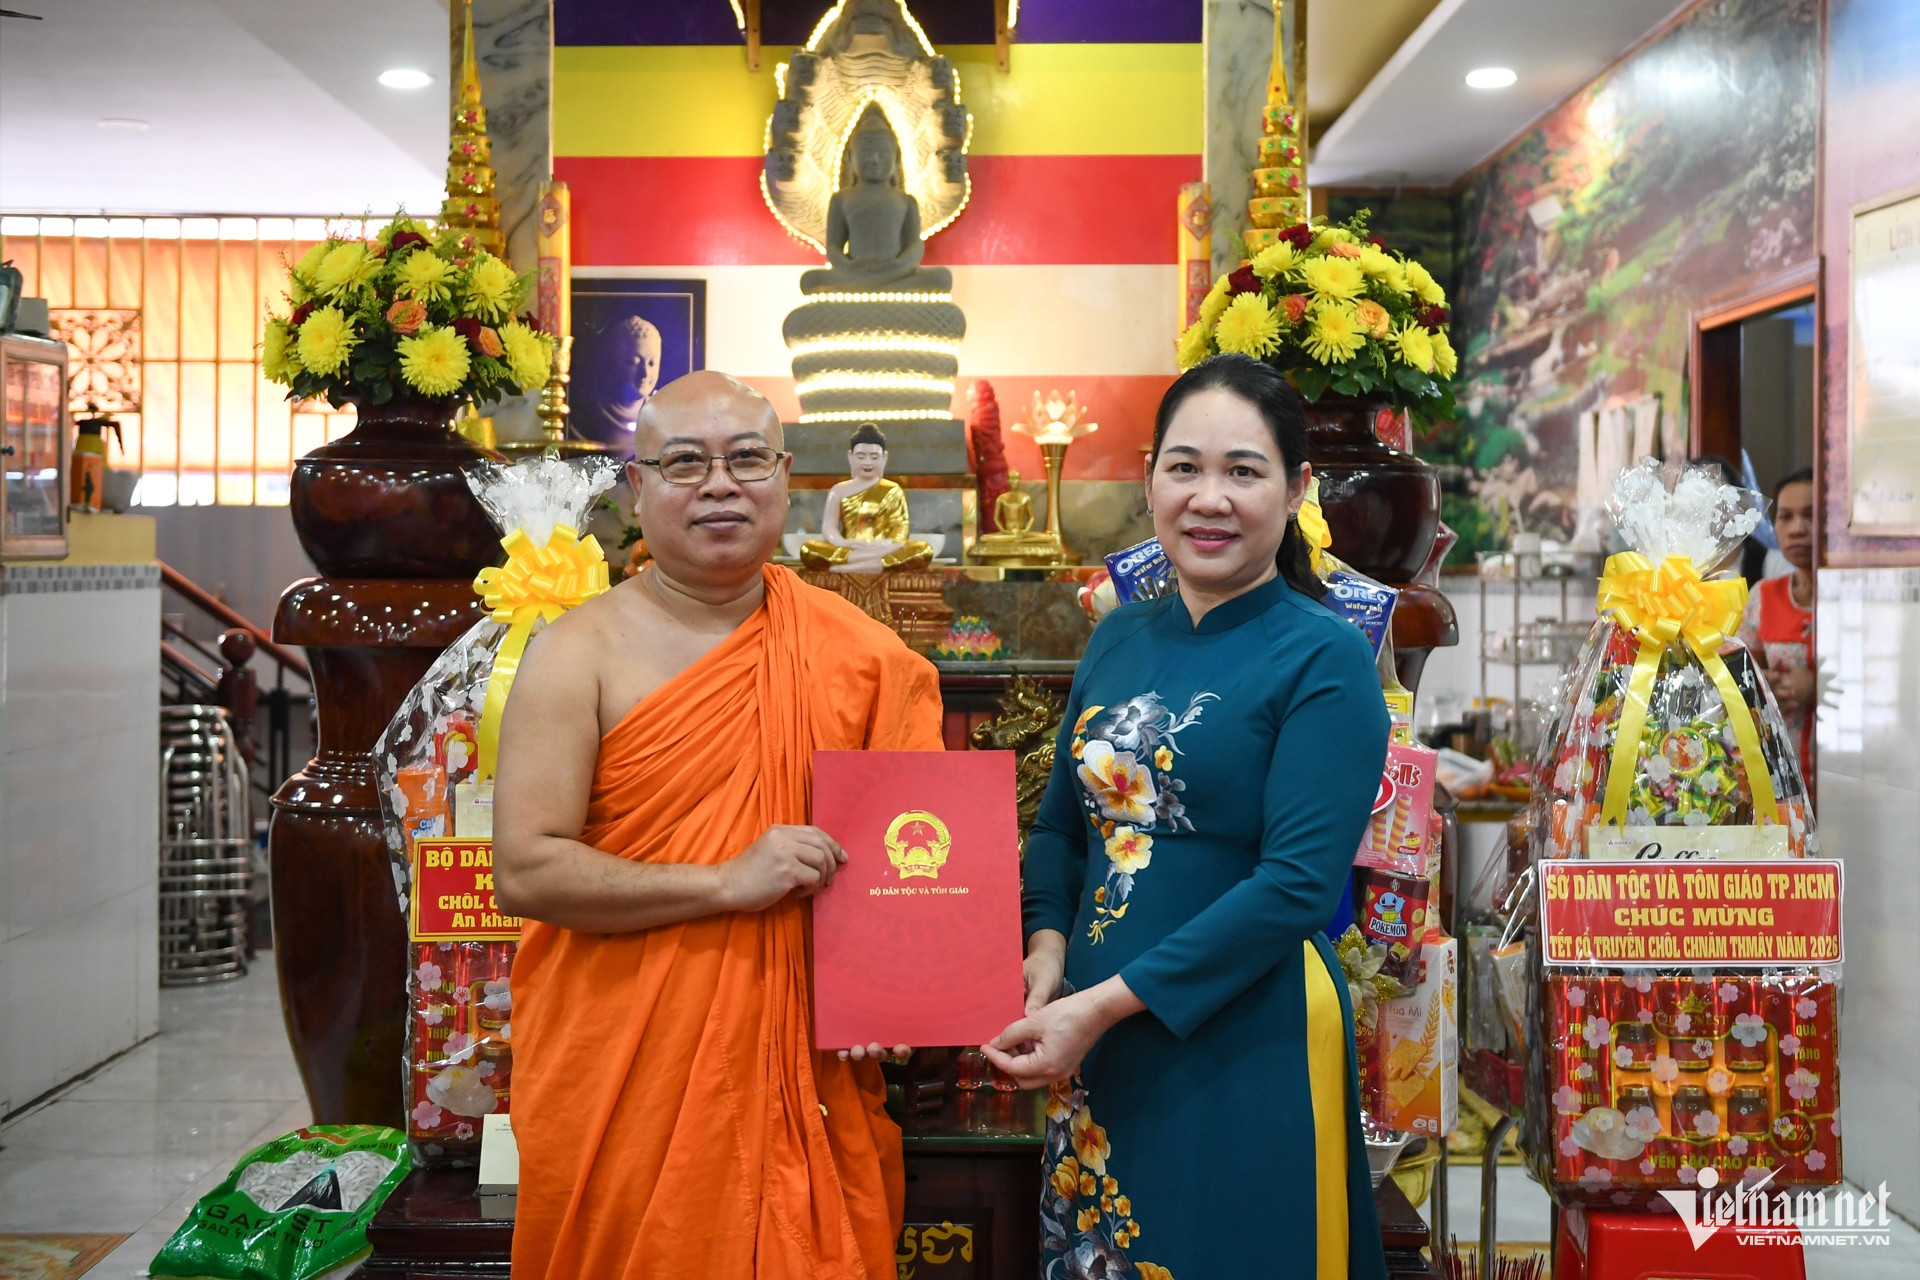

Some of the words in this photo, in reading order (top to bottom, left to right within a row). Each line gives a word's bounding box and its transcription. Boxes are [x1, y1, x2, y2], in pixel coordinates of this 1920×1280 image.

[1117, 544, 1162, 574] OREO
[1133, 562, 1153, 577] Wafer
[1334, 585, 1389, 603] OREO
[1344, 602, 1368, 610] Wafer
[425, 846, 454, 871] BỘ
[460, 846, 492, 868] DÂ
[869, 886, 881, 897] BỘ
[882, 886, 900, 895] DÂN
[901, 886, 918, 897] TỘC
[919, 885, 930, 895] VÀ
[931, 886, 948, 895] TÔN
[949, 886, 970, 895] GIÁO
[1546, 867, 1570, 900] SỞ
[1573, 869, 1612, 900] DÂN
[1616, 868, 1651, 905] TỘC
[1655, 868, 1680, 900] VÀ
[1683, 868, 1720, 900] TÔN
[1723, 868, 1764, 900] GIÁO
[1767, 873, 1836, 900] TP.HCM
[438, 892, 485, 910] CHÔL
[451, 912, 476, 928] An
[481, 912, 523, 928] khan
[1614, 904, 1685, 926] CHÚC
[1692, 903, 1775, 926] MỪNG
[1550, 926, 1573, 958] TẾT
[1576, 926, 1592, 958] CỔ
[1593, 926, 1646, 958] TRUYỀN
[1648, 930, 1681, 958] CHÔL
[1683, 930, 1728, 958] CHNĂM
[1729, 930, 1774, 958] THMÂY
[1775, 930, 1808, 958] NĂM
[1809, 934, 1838, 958] 2026
[1796, 1023, 1817, 1036] QUÀ
[1713, 1155, 1743, 1169] CAO
